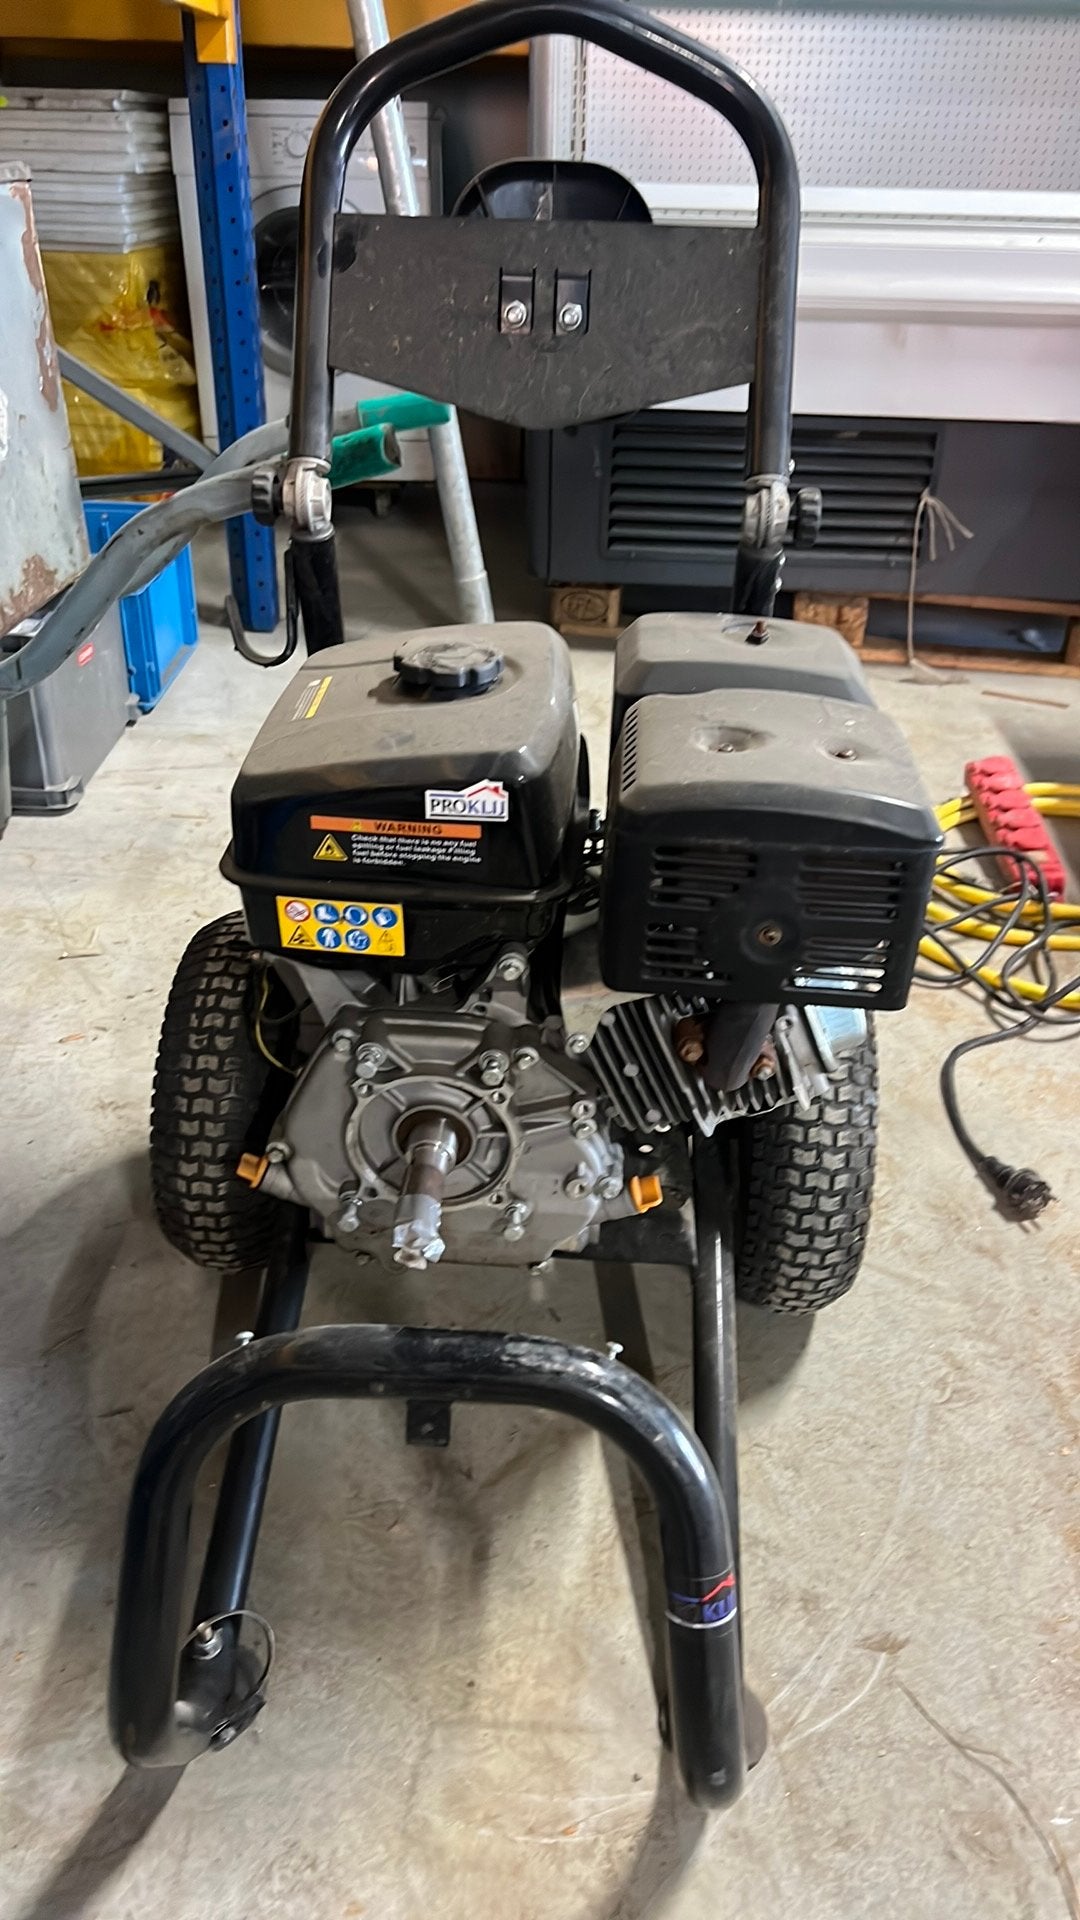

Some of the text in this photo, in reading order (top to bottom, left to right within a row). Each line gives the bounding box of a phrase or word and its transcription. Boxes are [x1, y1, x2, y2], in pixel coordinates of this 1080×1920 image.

[430, 798, 505, 816] PROKLIJ
[373, 820, 443, 835] WARNING
[351, 833, 378, 842] Check
[379, 835, 396, 843] that
[442, 840, 459, 849] any
[460, 839, 478, 848] fuel
[395, 844, 412, 852] fuel
[352, 848, 482, 864] fuel before stopping the engine
[352, 856, 361, 864] is
